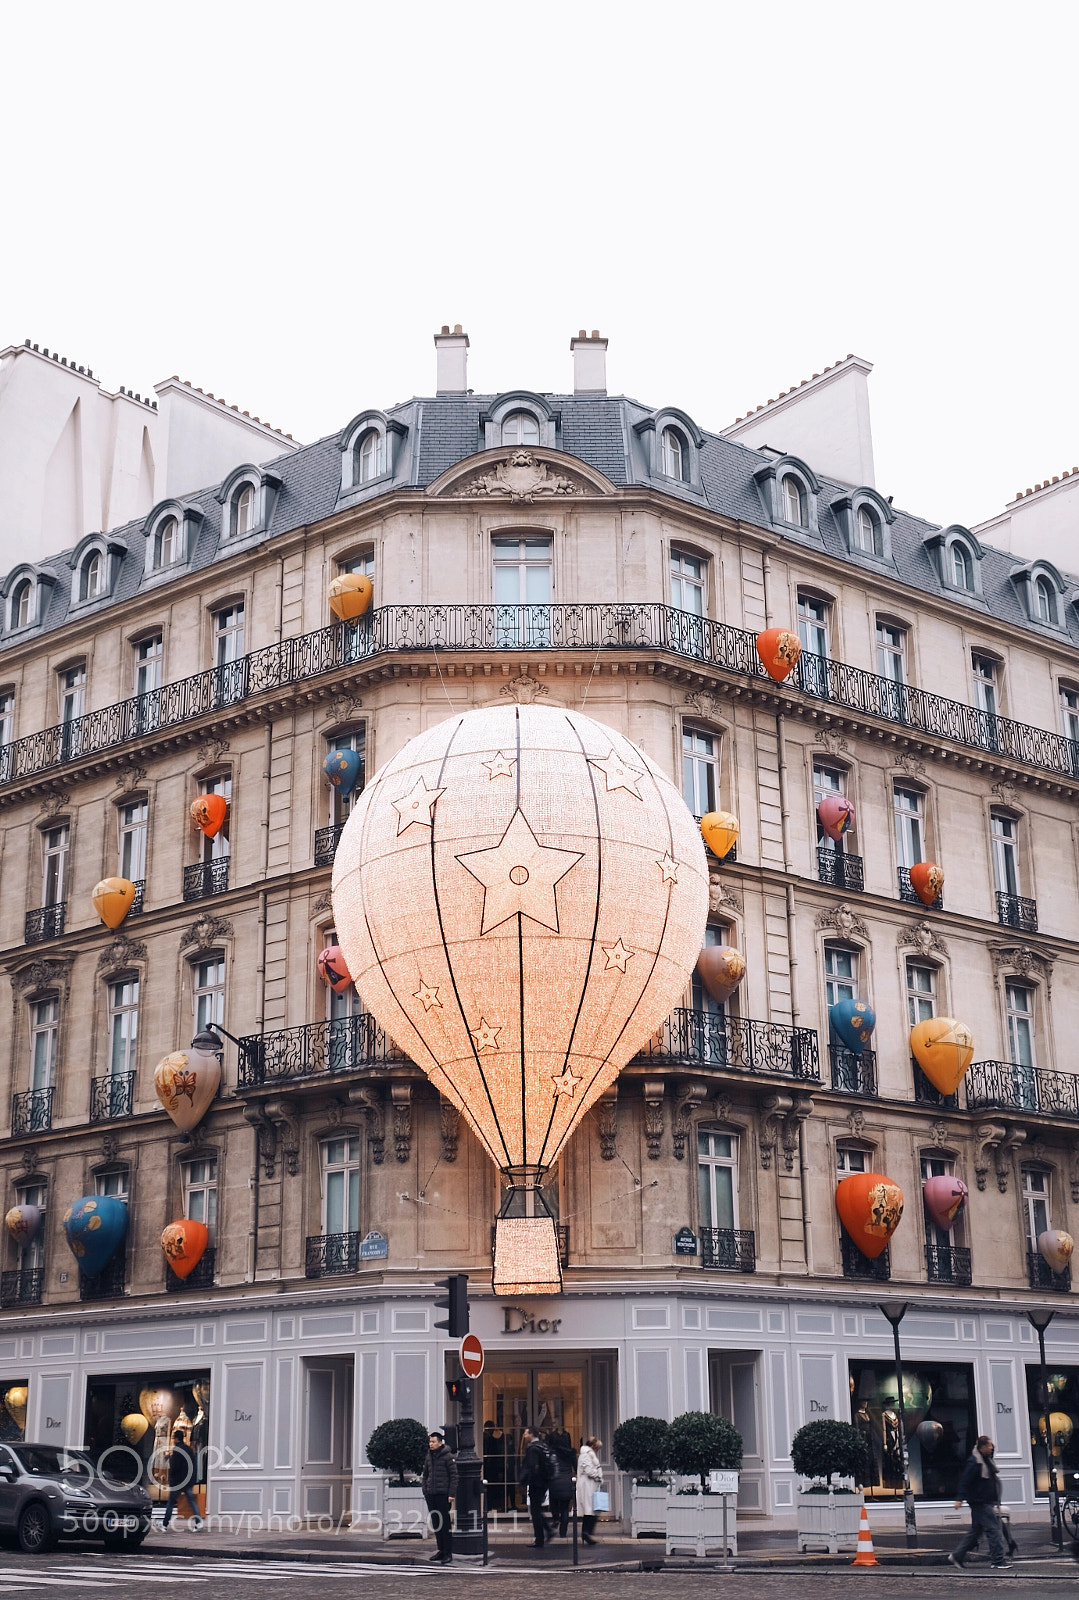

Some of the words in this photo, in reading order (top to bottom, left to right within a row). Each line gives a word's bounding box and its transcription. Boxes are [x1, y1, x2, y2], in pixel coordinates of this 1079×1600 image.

[501, 1306, 562, 1334] Dior
[810, 1400, 828, 1412] Dior
[997, 1402, 1012, 1414] Dior
[234, 1409, 252, 1421] Dior
[46, 1416, 61, 1428] Dior
[715, 1472, 734, 1482] Dior
